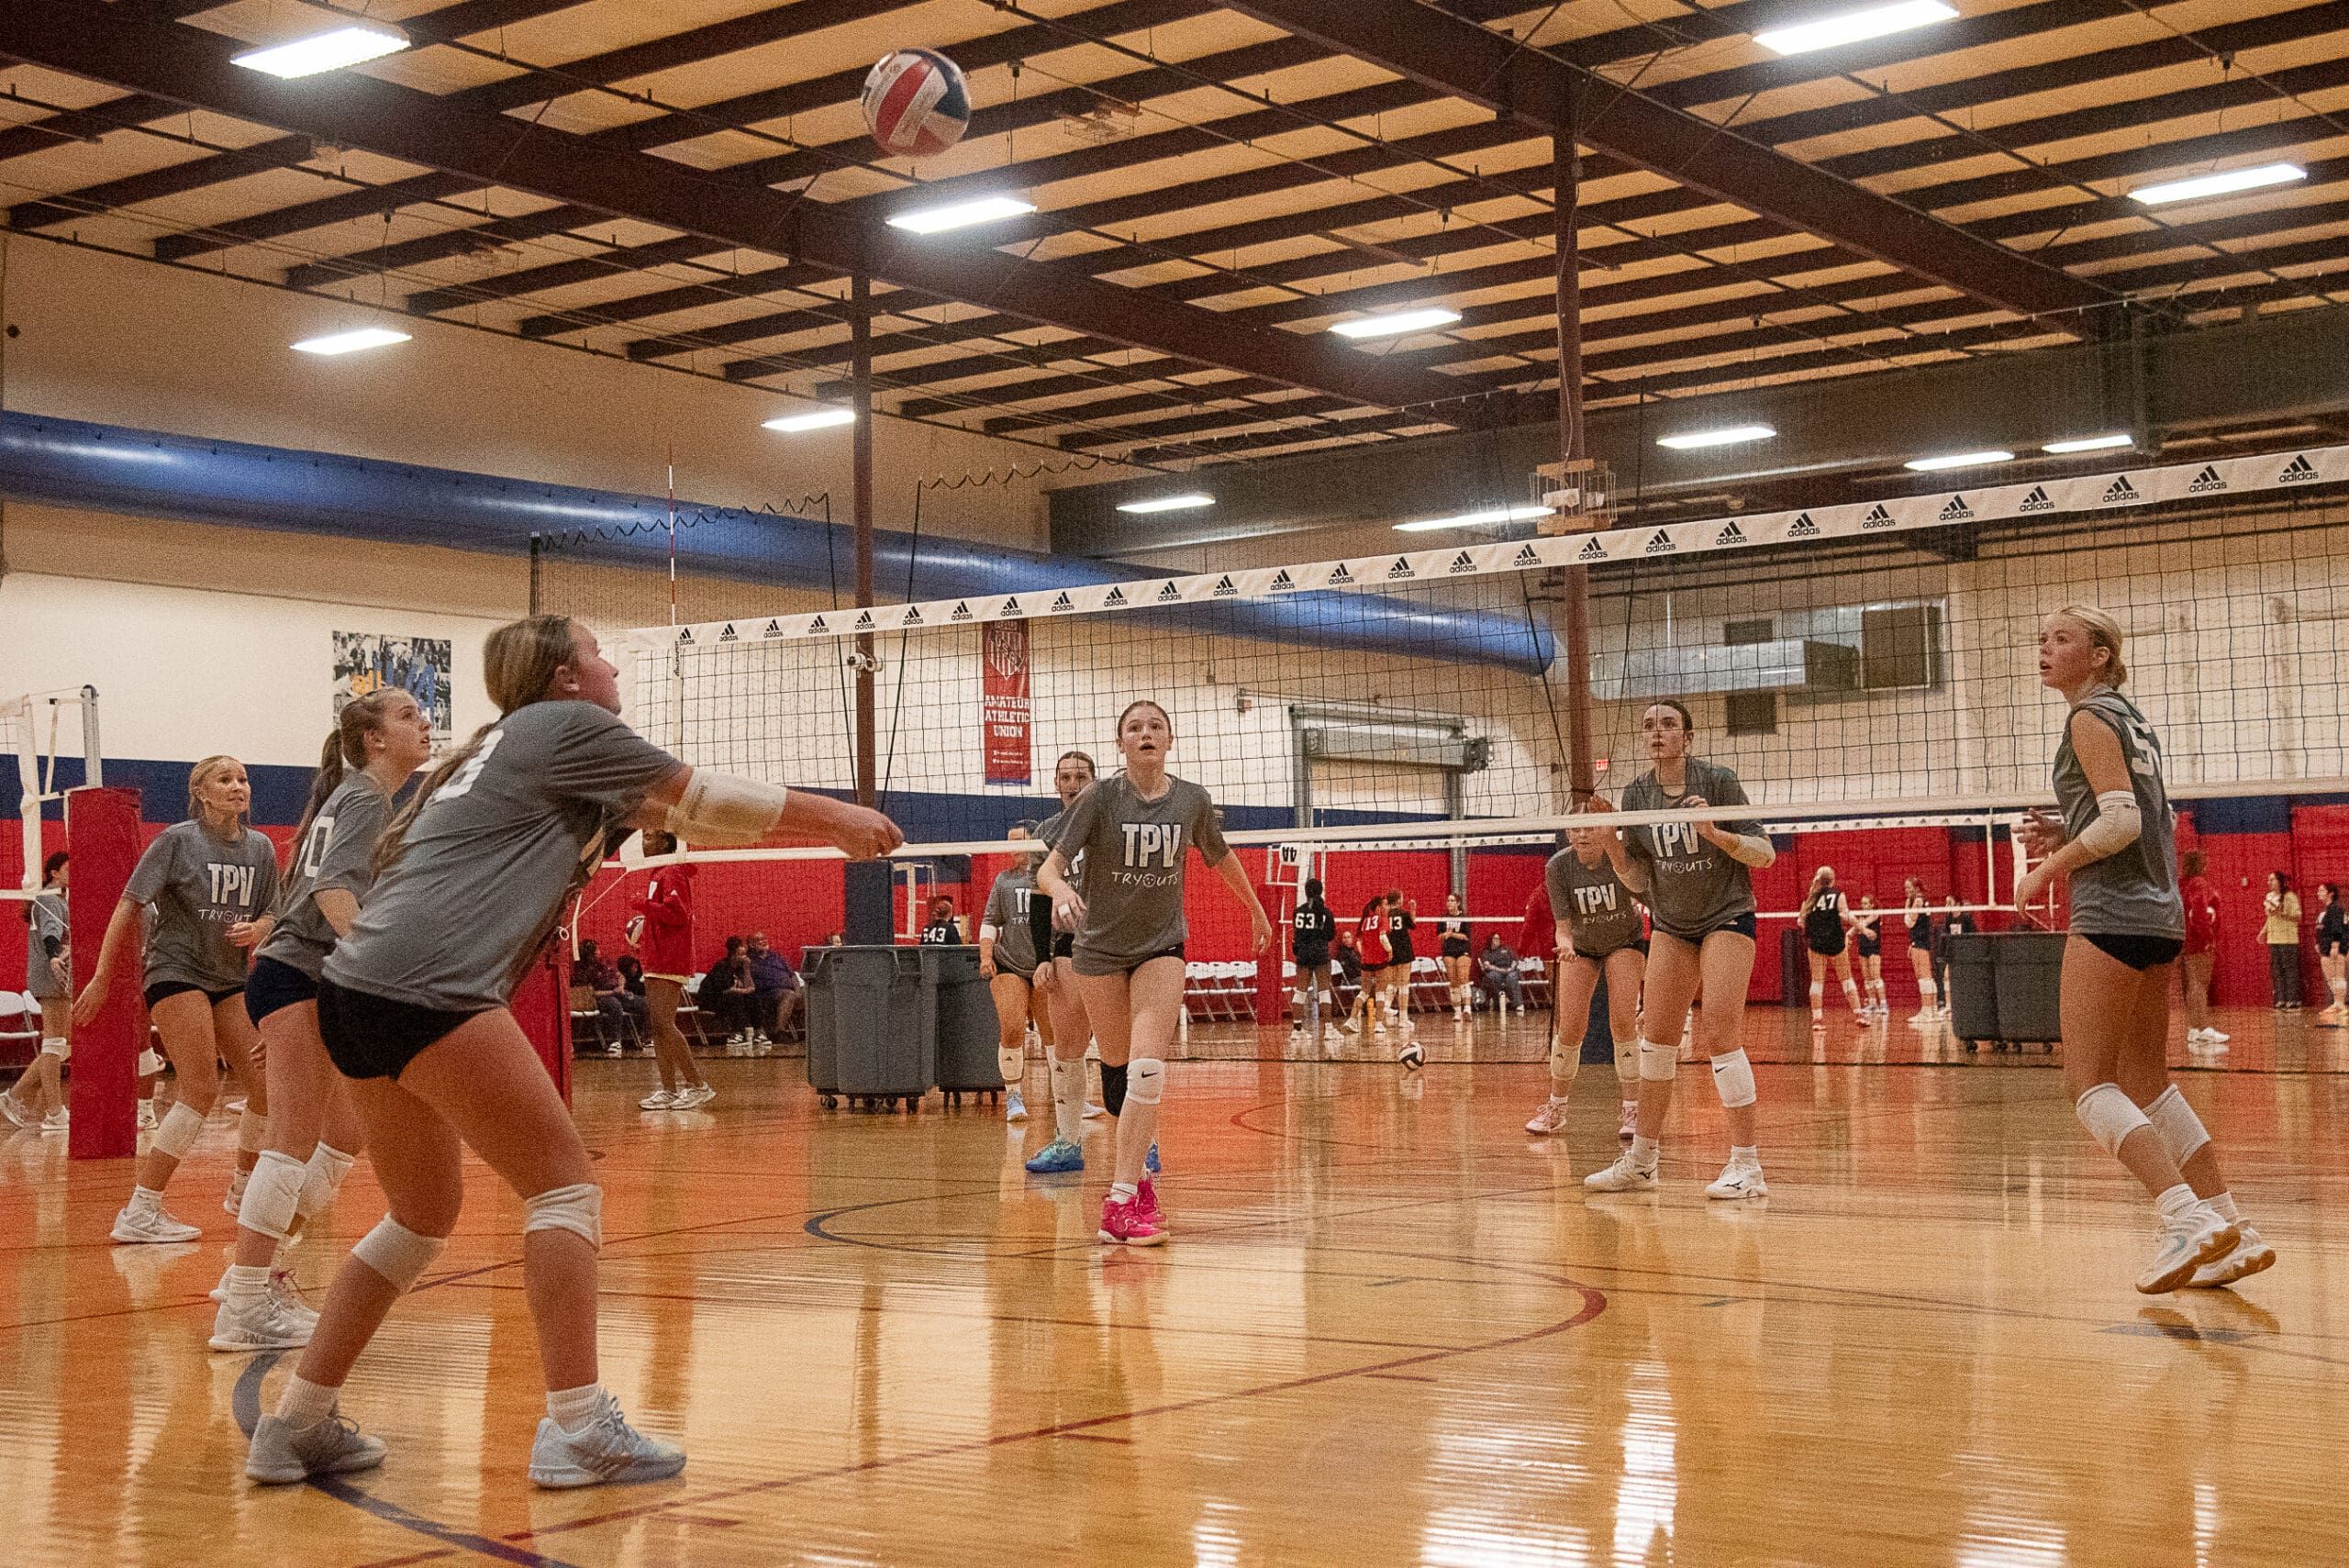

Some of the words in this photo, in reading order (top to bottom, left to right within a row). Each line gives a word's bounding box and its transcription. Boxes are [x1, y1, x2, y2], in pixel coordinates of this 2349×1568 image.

[1214, 588, 1238, 596] adidas
[1271, 583, 1295, 591] adidas
[1329, 576, 1354, 584] adidas
[1388, 571, 1415, 579] adidas
[1450, 565, 1477, 573] adidas
[1514, 558, 1542, 566] adidas
[1579, 551, 1608, 560] adidas
[1646, 543, 1675, 552] adidas
[1716, 536, 1747, 545] adidas
[1787, 528, 1820, 537] adidas
[1863, 518, 1896, 528] adidas
[1939, 510, 1974, 520] adidas
[2020, 501, 2054, 512] adidas
[2103, 492, 2139, 502] adidas
[2189, 482, 2227, 493] adidas
[2279, 472, 2319, 483] adidas
[985, 695, 1029, 709] AMATEUR
[985, 709, 1030, 723] ATHLETIC
[994, 725, 1023, 738] UNION
[2123, 717, 2162, 776] 5
[1122, 823, 1181, 868] TPV
[1649, 822, 1699, 858] TPV
[1654, 857, 1713, 874] TRYOUTS
[207, 862, 255, 906] TPV
[1111, 871, 1179, 888] TRYOUTS
[1574, 883, 1617, 915] TPV
[198, 908, 253, 924] TRYOUT
